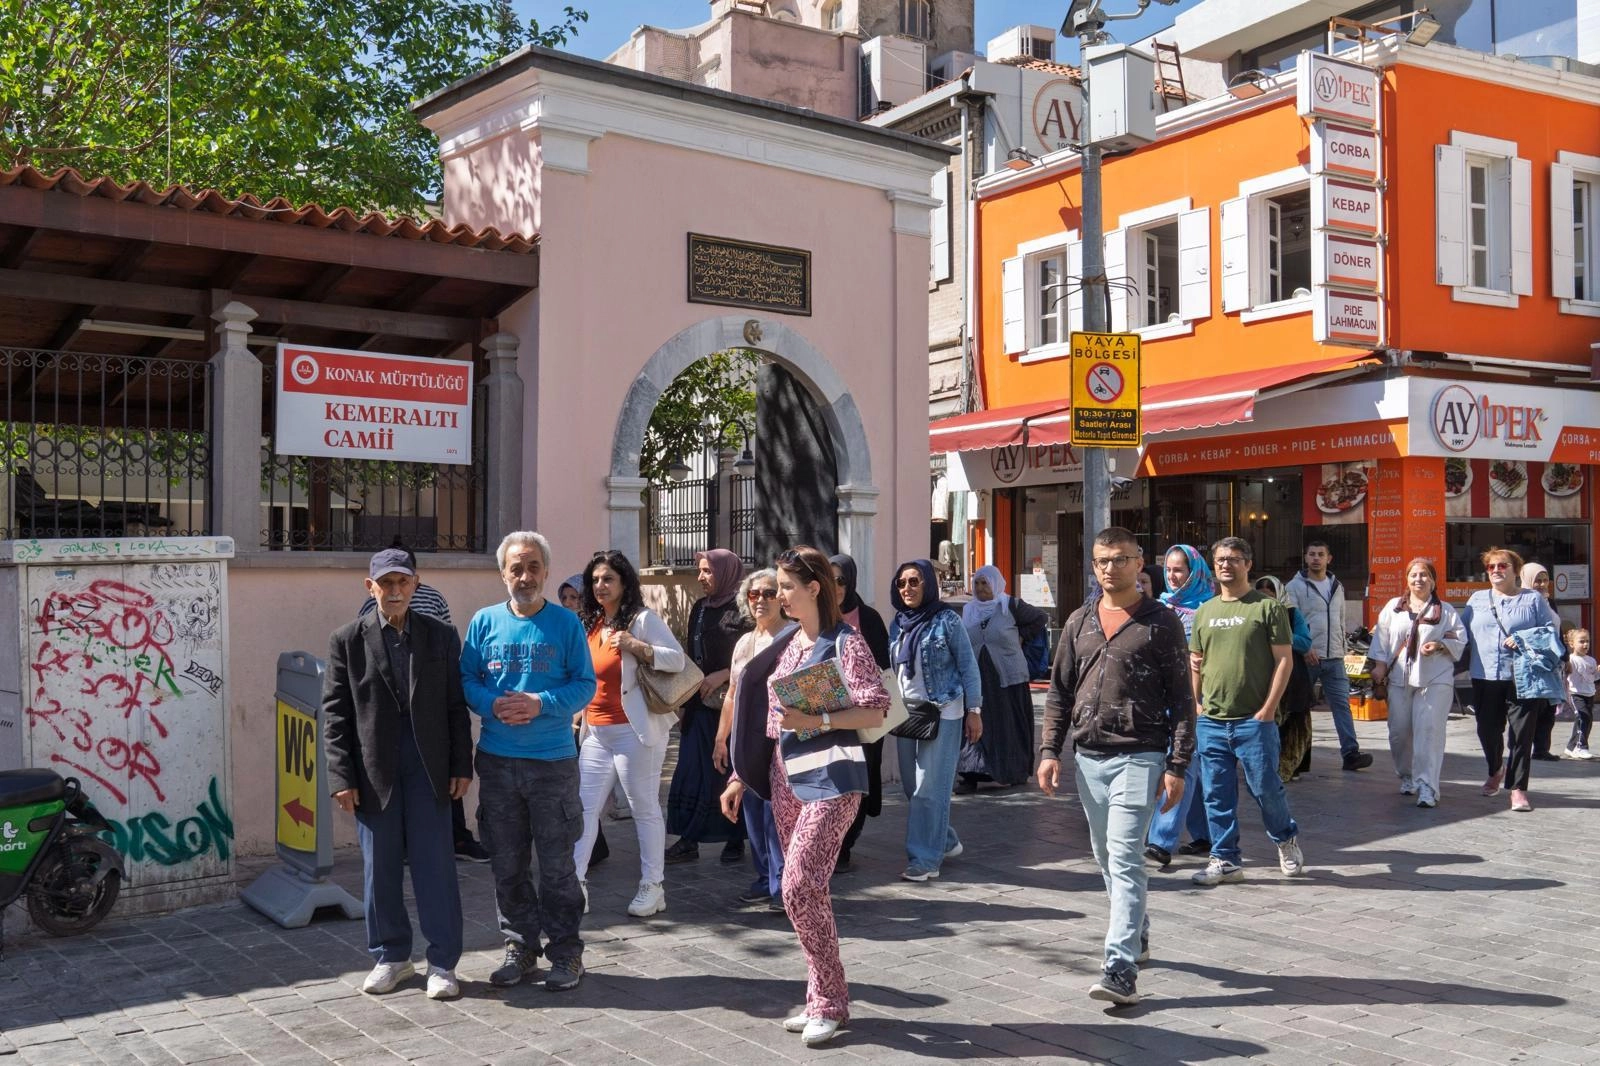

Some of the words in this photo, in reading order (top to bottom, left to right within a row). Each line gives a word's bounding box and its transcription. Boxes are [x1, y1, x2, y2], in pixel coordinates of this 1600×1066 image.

[1317, 76, 1335, 94] AY
[1041, 99, 1082, 140] AY
[1332, 197, 1370, 213] KEBAP
[1333, 252, 1371, 268] DÖNER
[1330, 315, 1377, 331] LAHMACUN
[1085, 335, 1125, 347] YAYA
[1075, 347, 1136, 360] BÖLGESİ
[325, 367, 375, 384] KONAK
[380, 370, 465, 391] MÜFTÜLÜĞÜ
[324, 402, 459, 428] KEMERALTI
[1440, 401, 1475, 435] AY
[1080, 420, 1108, 428] Saatleri
[324, 428, 395, 450] CAMİİ
[1561, 433, 1590, 446] ÇORBA
[1201, 448, 1231, 461] KEBAP
[1244, 444, 1278, 457] DÖNER
[283, 714, 314, 783] WC
